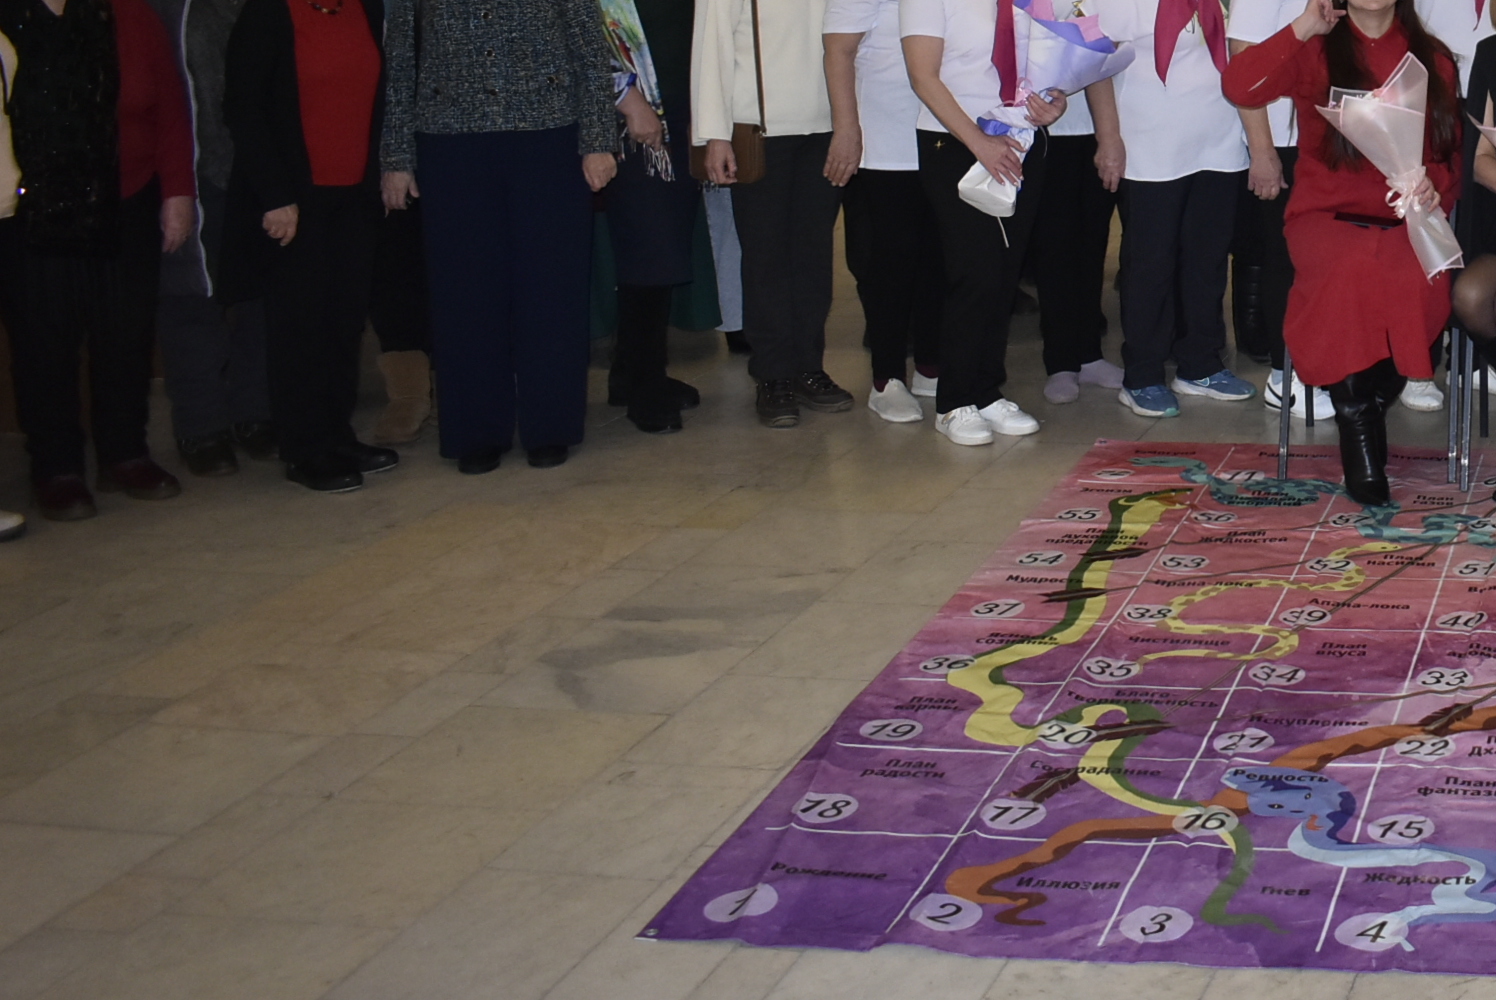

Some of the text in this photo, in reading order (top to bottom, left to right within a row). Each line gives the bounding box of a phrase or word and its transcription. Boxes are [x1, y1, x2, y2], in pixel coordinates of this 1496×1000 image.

[1057, 508, 1100, 521] 55
[1194, 512, 1235, 522] 56
[1332, 515, 1370, 525] 57
[1020, 553, 1065, 565] 54
[1164, 556, 1206, 568] 53
[1309, 559, 1351, 570] 52
[1458, 562, 1494, 575] 51
[1006, 575, 1084, 584] Мудрость
[974, 602, 1022, 615] 37
[1127, 608, 1173, 620] 38
[1283, 610, 1327, 622] 39
[1315, 648, 1367, 657] вкуса
[1321, 642, 1367, 651] План
[922, 657, 975, 670] 36
[1086, 660, 1133, 677] 35
[1252, 666, 1301, 683] 34
[1420, 670, 1468, 687] 33
[1115, 689, 1177, 698] Благо-
[1249, 715, 1369, 728] Искупление
[868, 722, 918, 738] 19
[1046, 725, 1098, 745] 20
[1400, 738, 1451, 756] 22
[885, 759, 937, 769] План
[1029, 760, 1162, 777] Сострадание
[860, 768, 945, 779] радости
[1233, 768, 1329, 783] Ревность
[799, 797, 852, 819] 18
[988, 804, 1040, 826] 17
[1182, 811, 1231, 830] 16
[1377, 819, 1426, 840] 15
[771, 861, 888, 880] Рождение
[1016, 876, 1121, 891] Иллюзия
[1364, 871, 1477, 887] Жадность
[1260, 885, 1311, 897] Гнев
[729, 889, 758, 916] 1
[926, 902, 964, 925] 2
[1140, 912, 1174, 936] 3
[1356, 921, 1389, 944] 4
